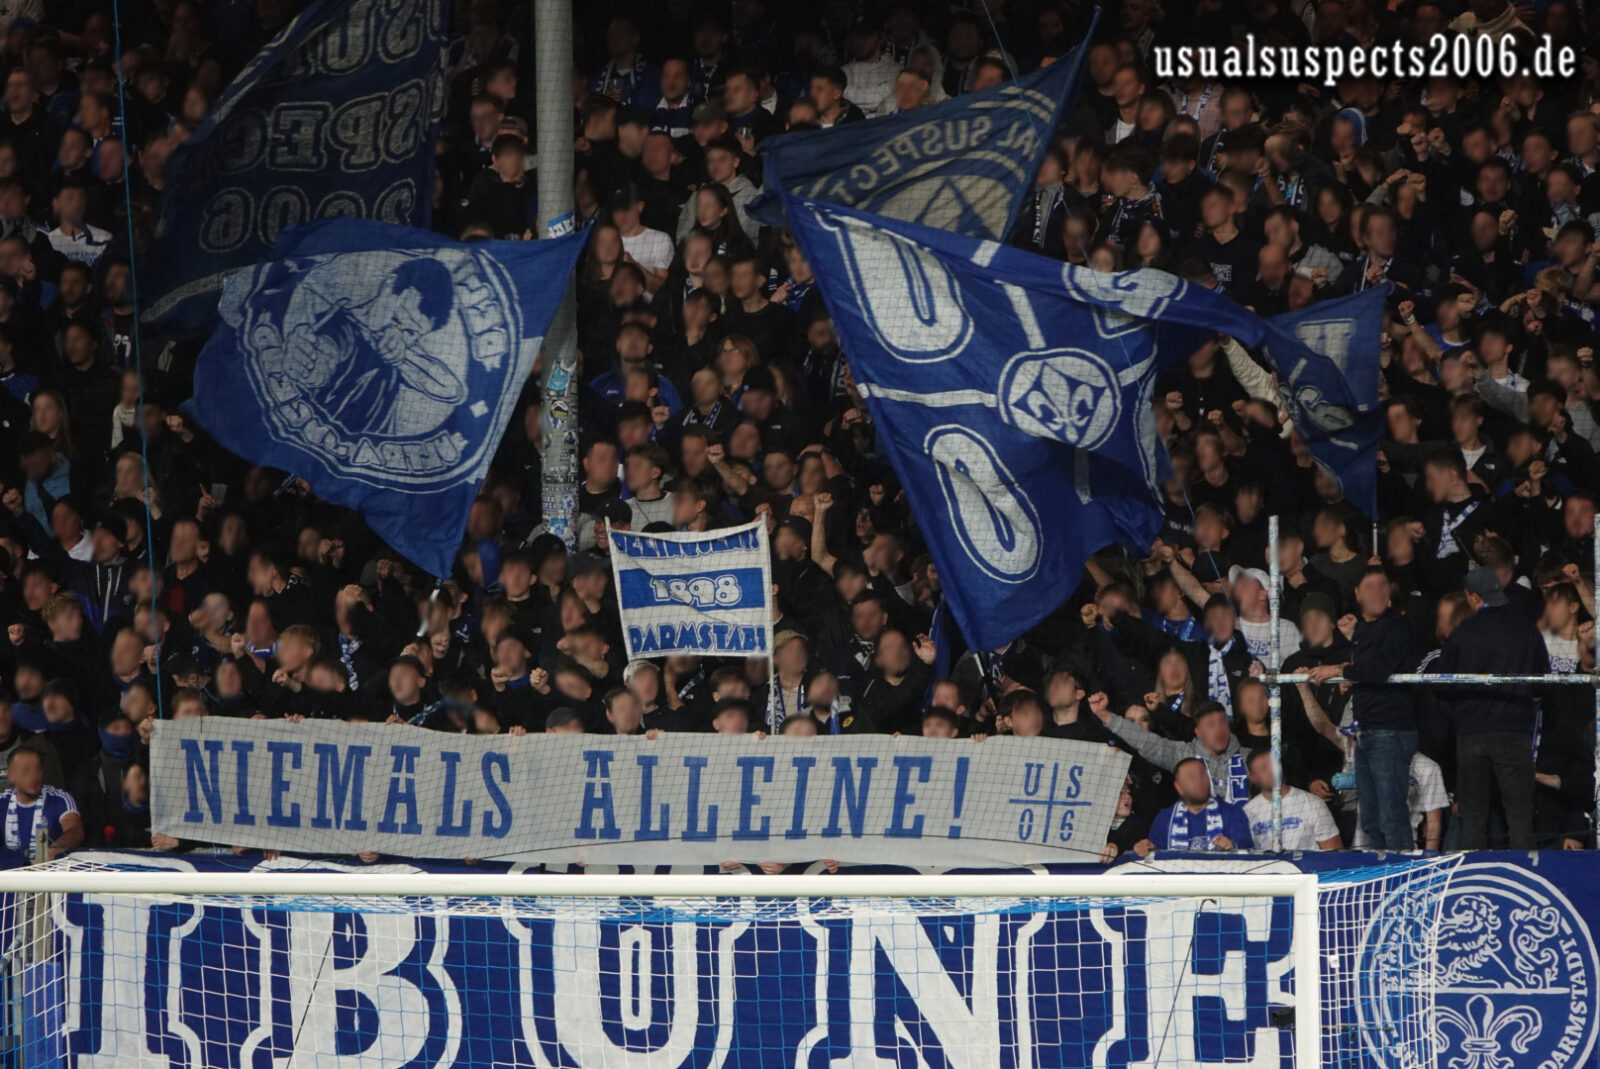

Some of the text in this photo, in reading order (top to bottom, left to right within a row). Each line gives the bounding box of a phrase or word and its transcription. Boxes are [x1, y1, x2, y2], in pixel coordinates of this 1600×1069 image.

[650, 574, 743, 607] 1898
[627, 620, 768, 656] DARMSTADT
[180, 738, 970, 843] NIEMALS ALLEINE!
